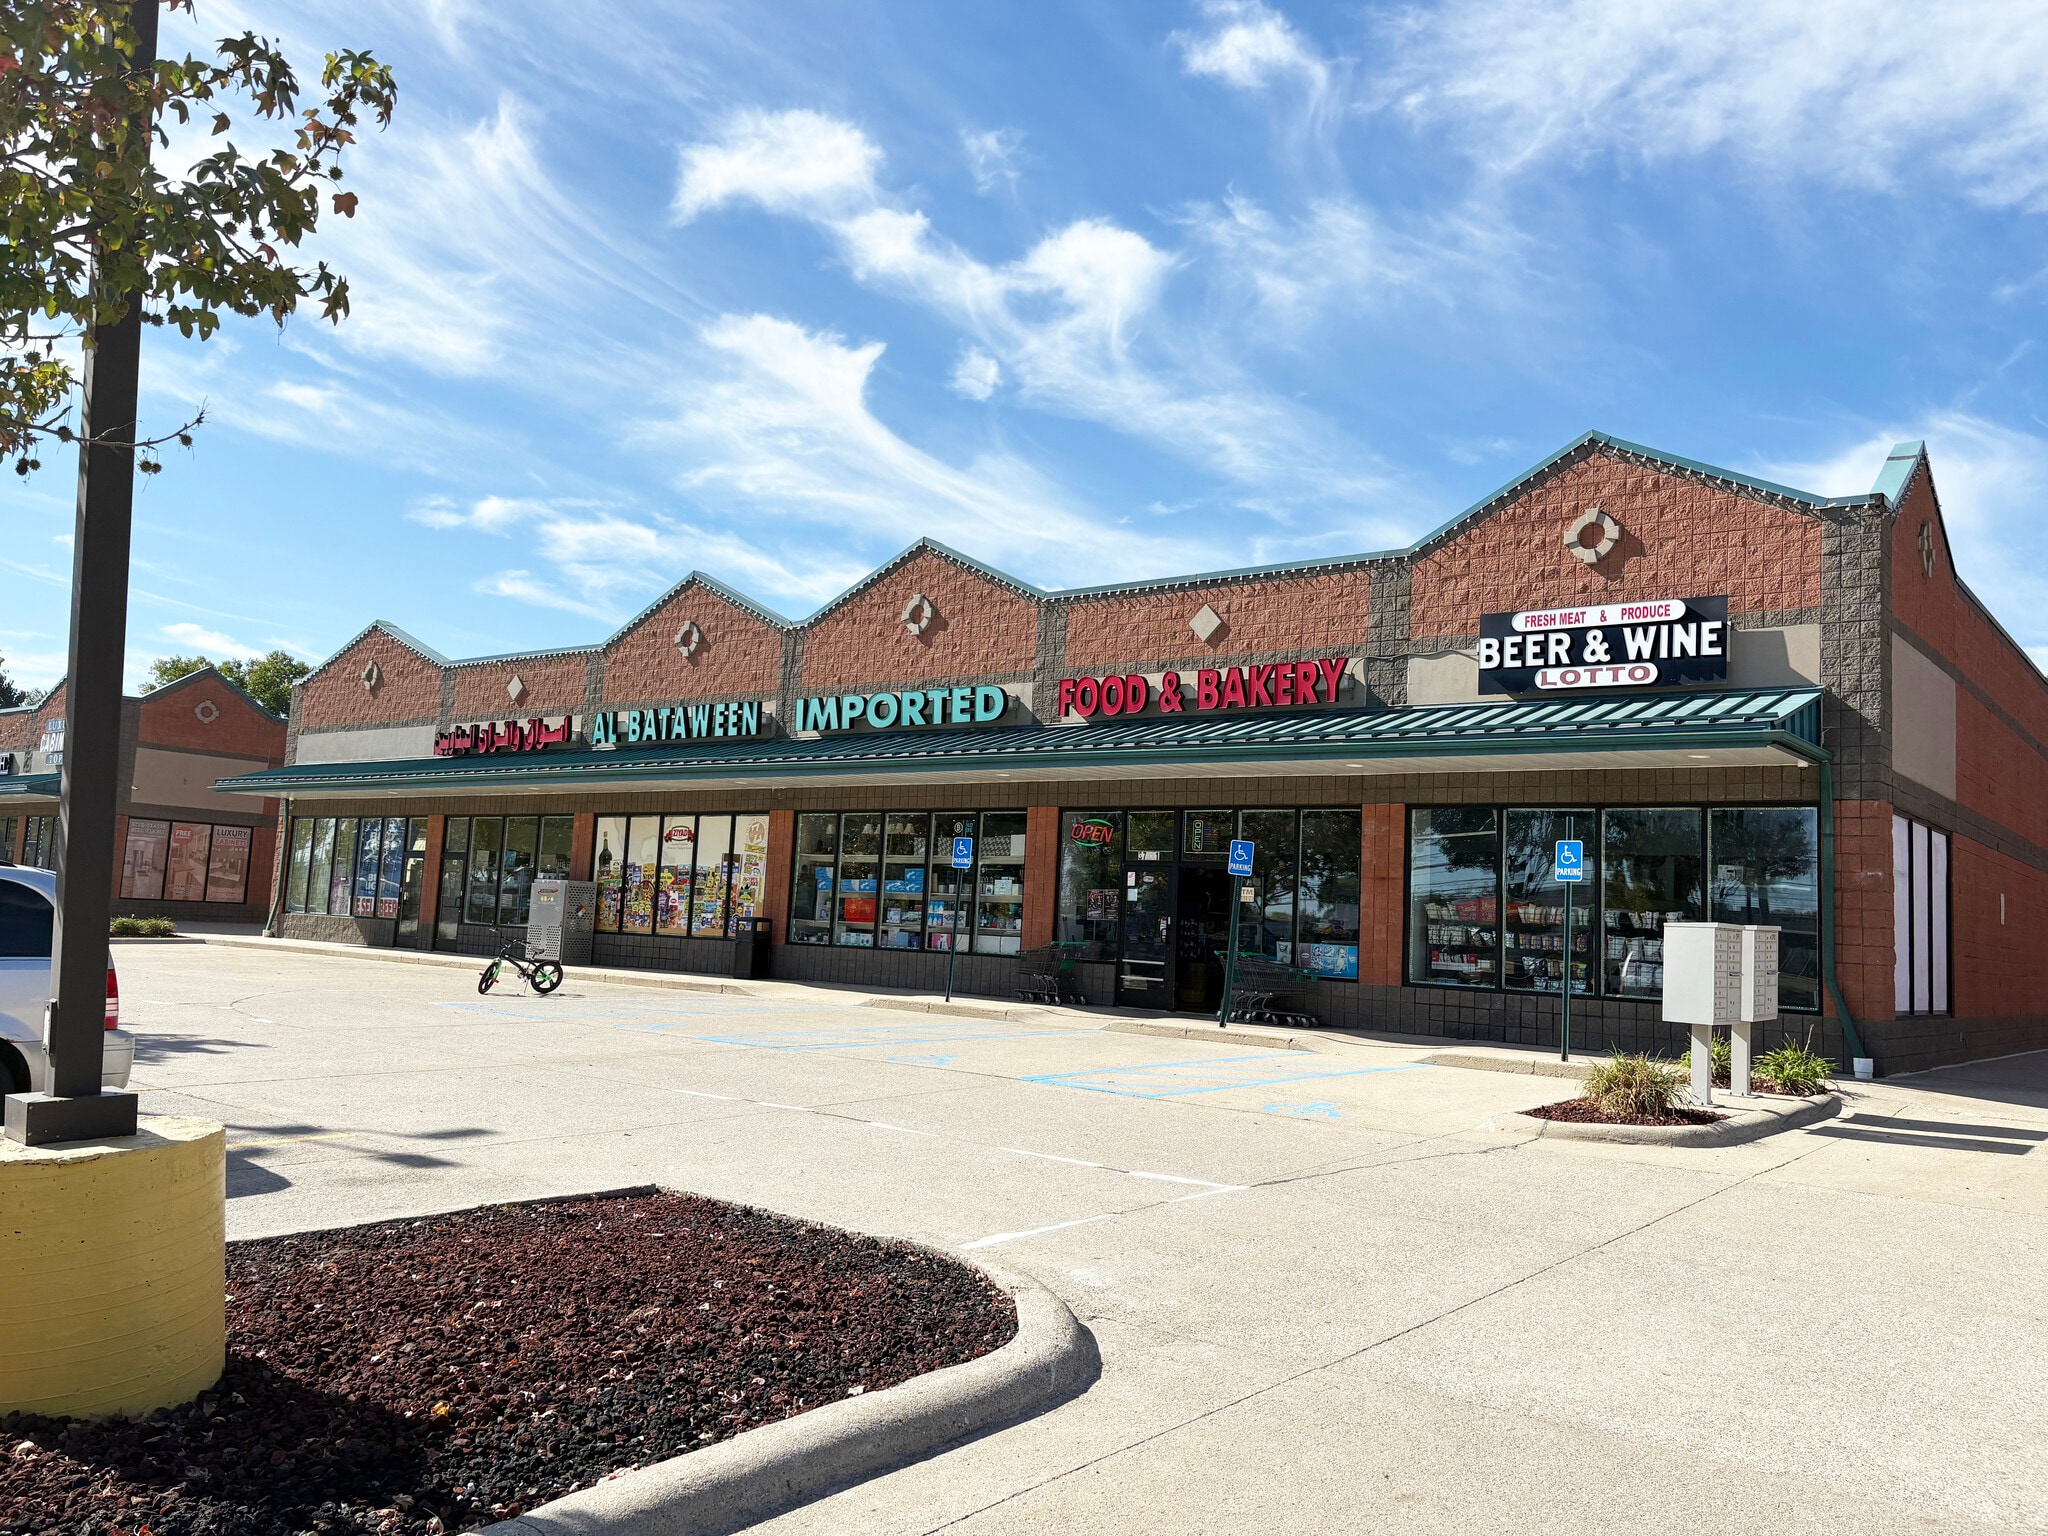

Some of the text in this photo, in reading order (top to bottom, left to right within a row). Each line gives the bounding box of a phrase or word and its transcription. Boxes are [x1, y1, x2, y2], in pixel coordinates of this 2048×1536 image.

[1524, 604, 1671, 628] FRESH MEAT & PRODUCE
[1479, 621, 1722, 670] BEER & WINE
[1058, 657, 1349, 717] FOOD & BAKERY
[1540, 665, 1651, 687] LOTTO
[795, 685, 1004, 732] IMPORTED
[592, 701, 758, 744] AL BATAWEEN
[175, 829, 192, 837] FREE
[216, 828, 248, 838] LUXURY
[1071, 823, 1114, 843] OPEN
[1193, 822, 1202, 850] OPEN
[1229, 862, 1251, 872] PARKING
[1556, 867, 1581, 876] PARKING
